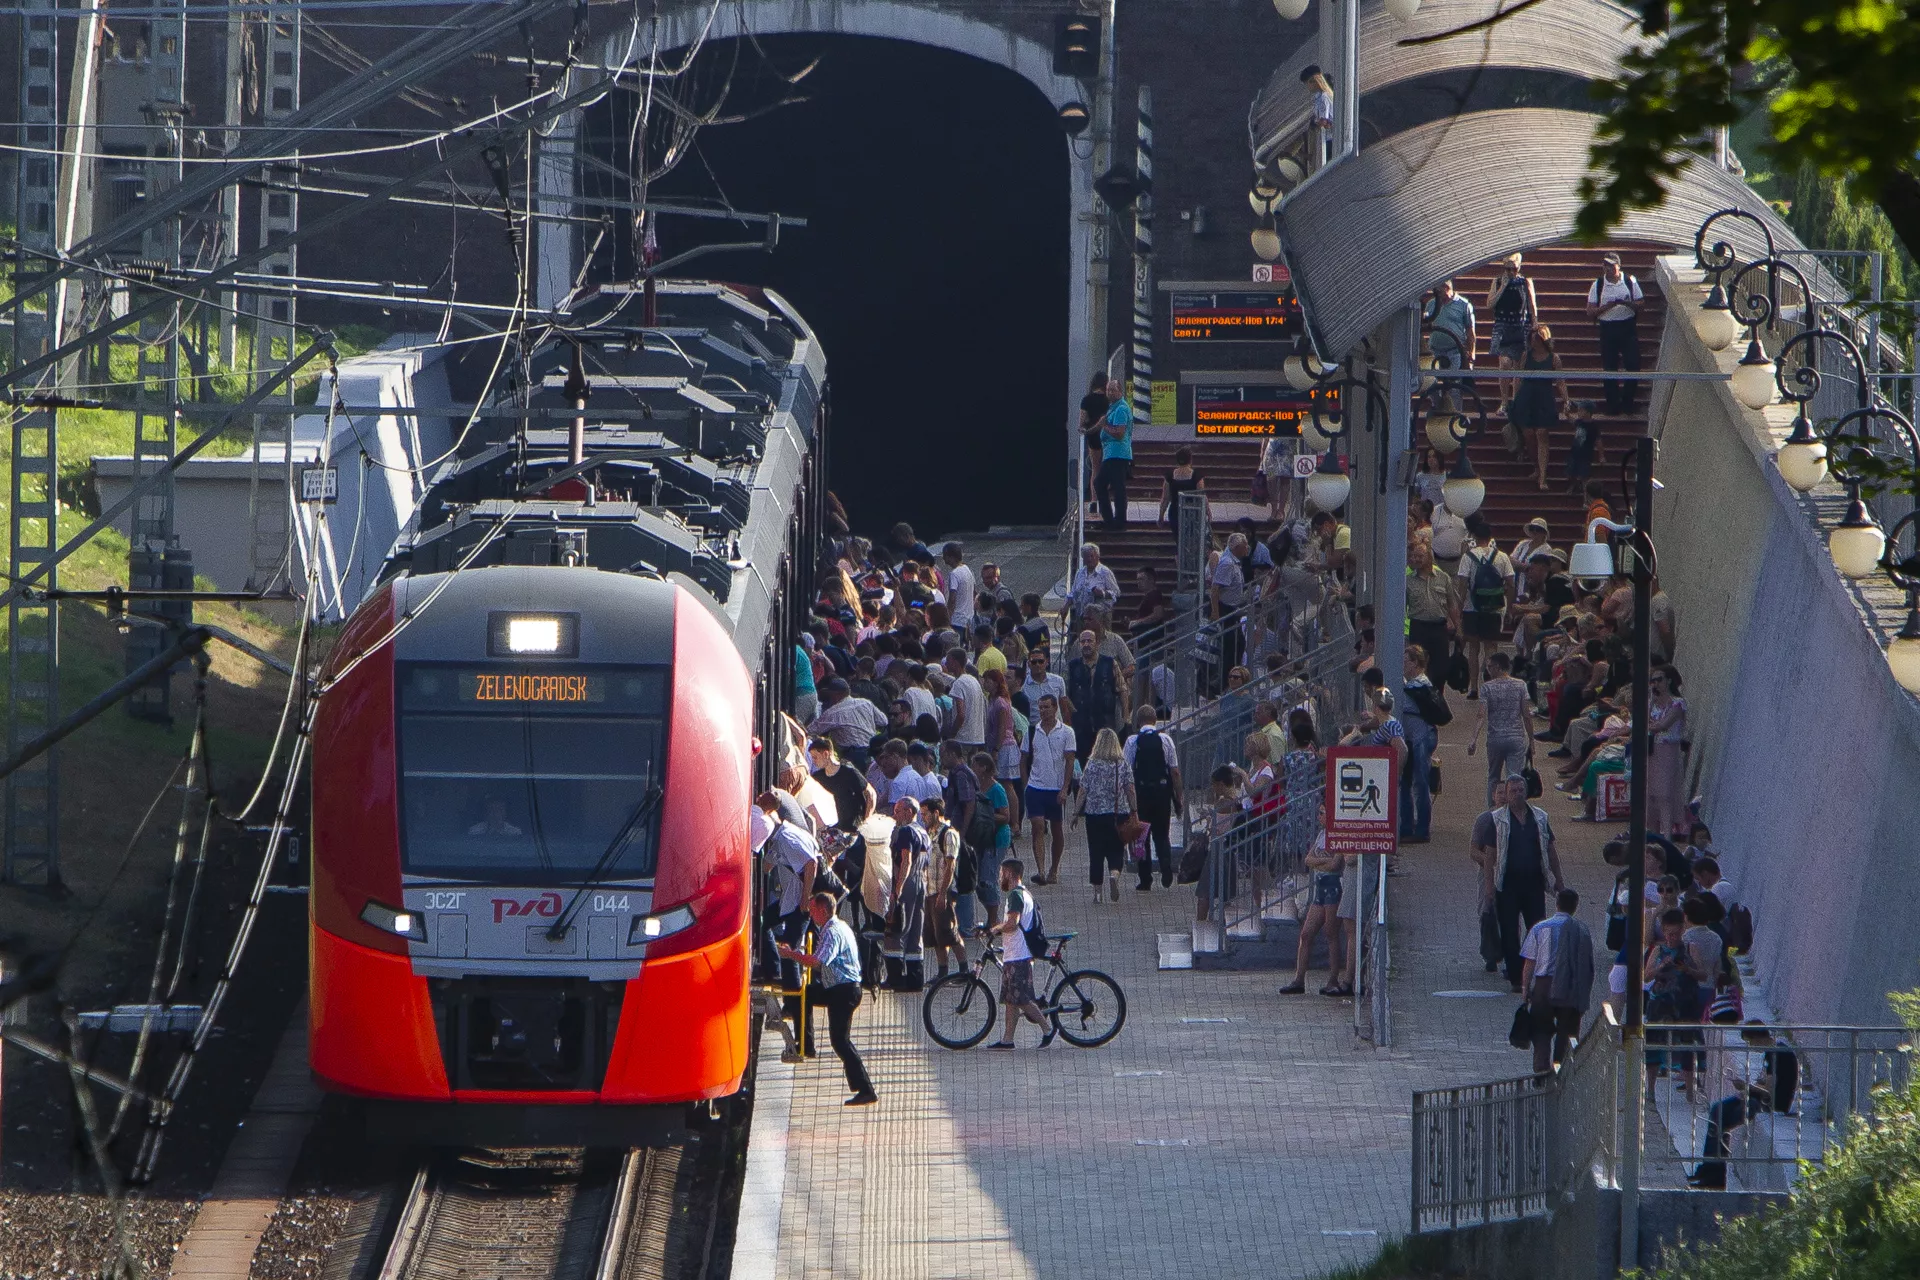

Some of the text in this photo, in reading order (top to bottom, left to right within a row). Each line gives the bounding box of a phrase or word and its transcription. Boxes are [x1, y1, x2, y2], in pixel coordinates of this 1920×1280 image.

[1210, 294, 1217, 308] 1
[1237, 387, 1244, 401] 1
[1197, 425, 1275, 434] Светлогорск-2
[476, 675, 587, 700] ZELENOGRADSK
[1330, 841, 1393, 851] ЗАПРЕЩЕНО!
[425, 893, 466, 910] ЭС2Г
[594, 895, 630, 911] 044
